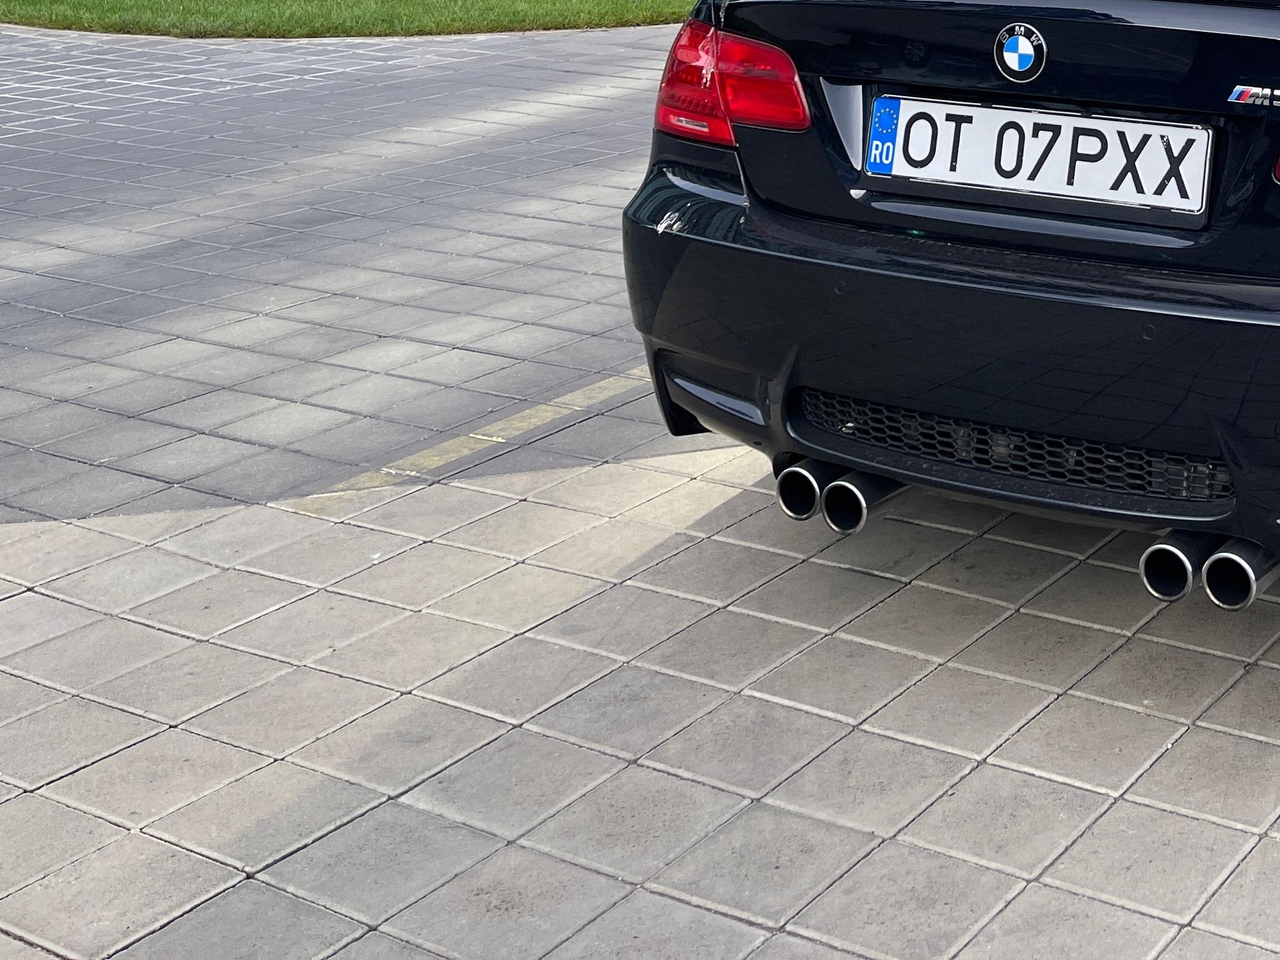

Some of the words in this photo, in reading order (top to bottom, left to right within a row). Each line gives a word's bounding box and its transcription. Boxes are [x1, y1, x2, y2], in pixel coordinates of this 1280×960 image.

[1000, 26, 1042, 47] BMW
[870, 140, 893, 165] RO
[902, 111, 974, 172] OT
[994, 120, 1196, 200] 07PXX
